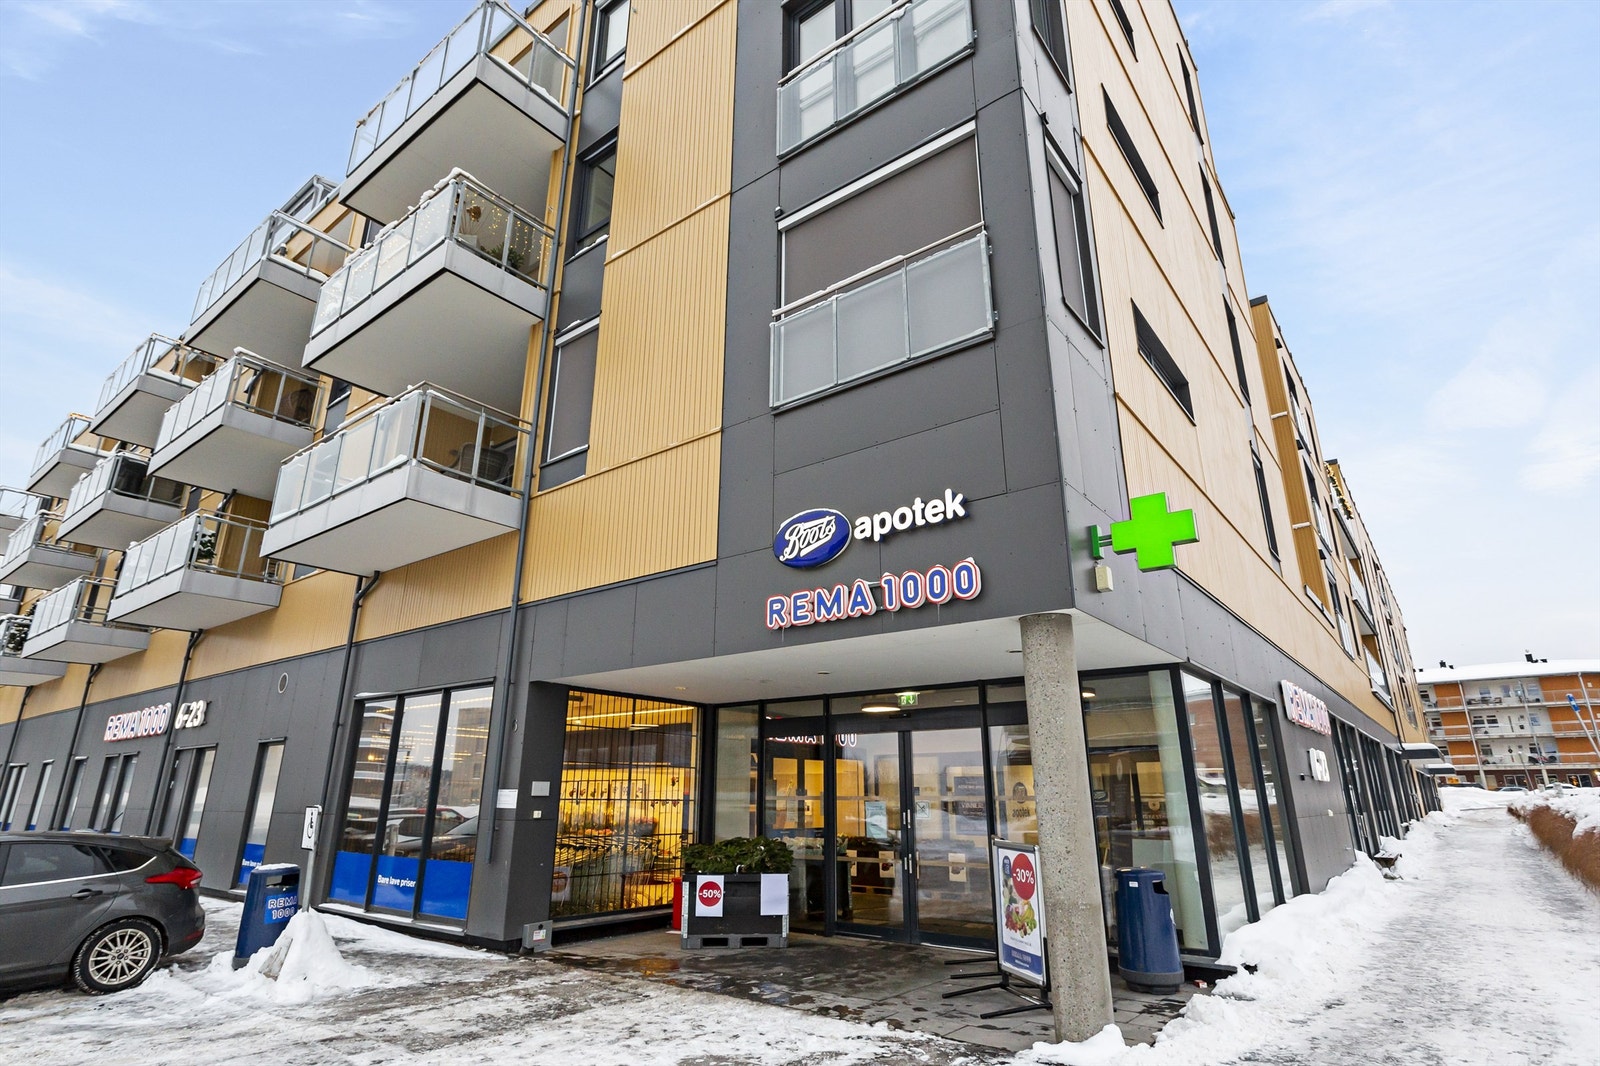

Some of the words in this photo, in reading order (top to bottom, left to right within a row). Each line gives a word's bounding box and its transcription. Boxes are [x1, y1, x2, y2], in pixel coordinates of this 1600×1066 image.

[779, 515, 837, 562] Boots
[853, 488, 967, 542] apotek
[765, 579, 877, 630] REMA
[880, 557, 982, 613] 1000
[104, 710, 141, 742] REMA
[139, 703, 172, 737] 1000
[175, 700, 207, 730] 6-23
[377, 874, 390, 885] Bare
[389, 876, 401, 886] lave
[400, 877, 417, 888] priser
[1013, 867, 1035, 885] -30%
[699, 890, 721, 899] -50%
